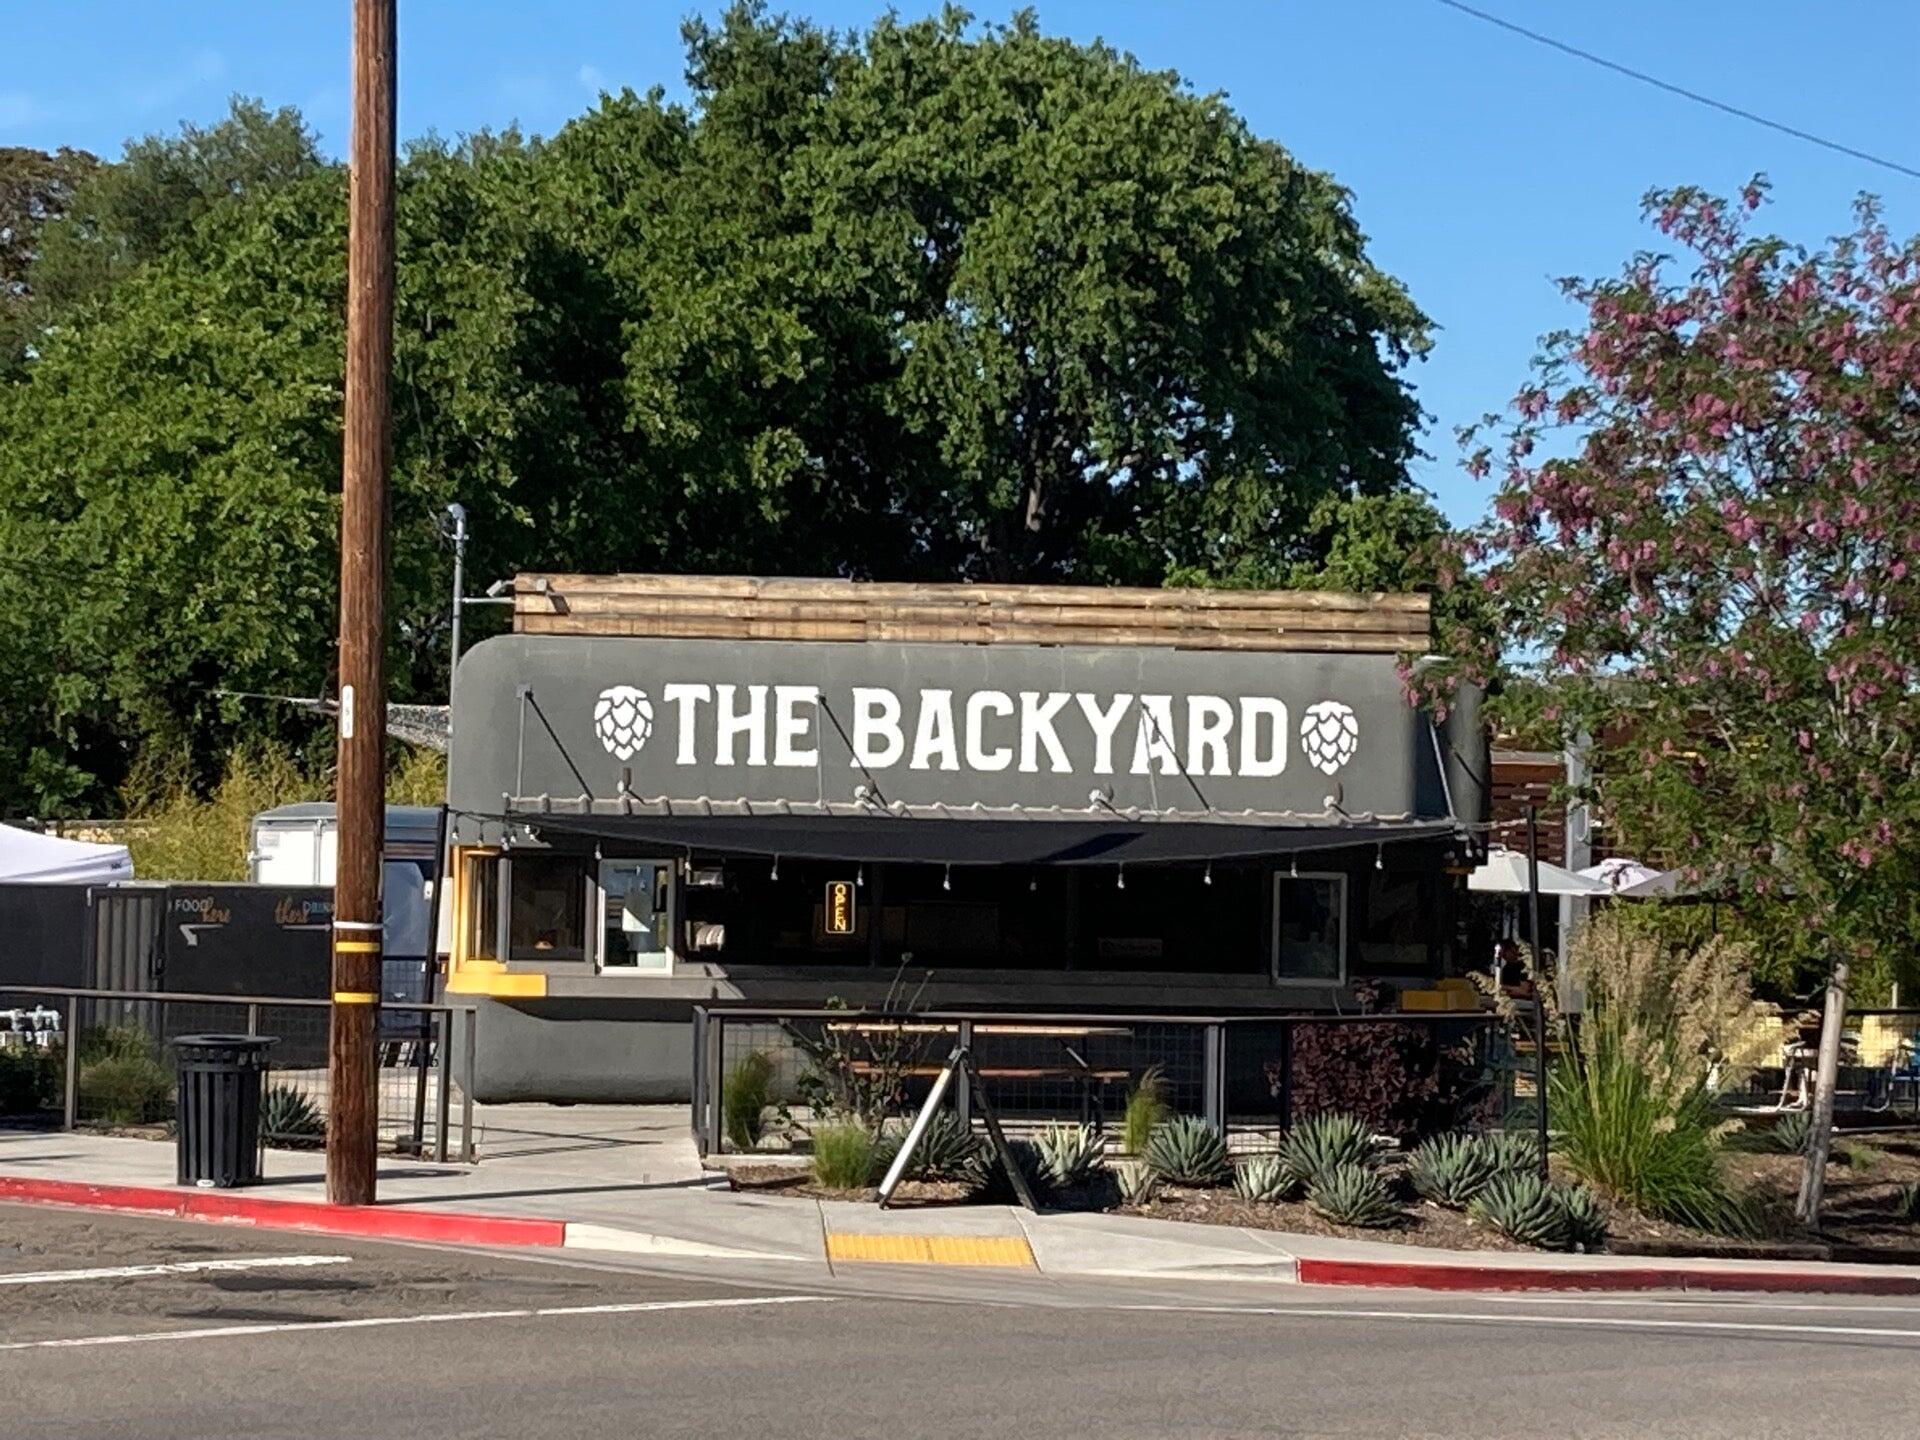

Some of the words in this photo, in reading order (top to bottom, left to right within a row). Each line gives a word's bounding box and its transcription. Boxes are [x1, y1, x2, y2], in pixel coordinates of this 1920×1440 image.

[664, 683, 820, 767] THE
[850, 687, 1289, 777] BACKYARD
[175, 898, 210, 913] FOOD
[834, 882, 847, 931] OPEN
